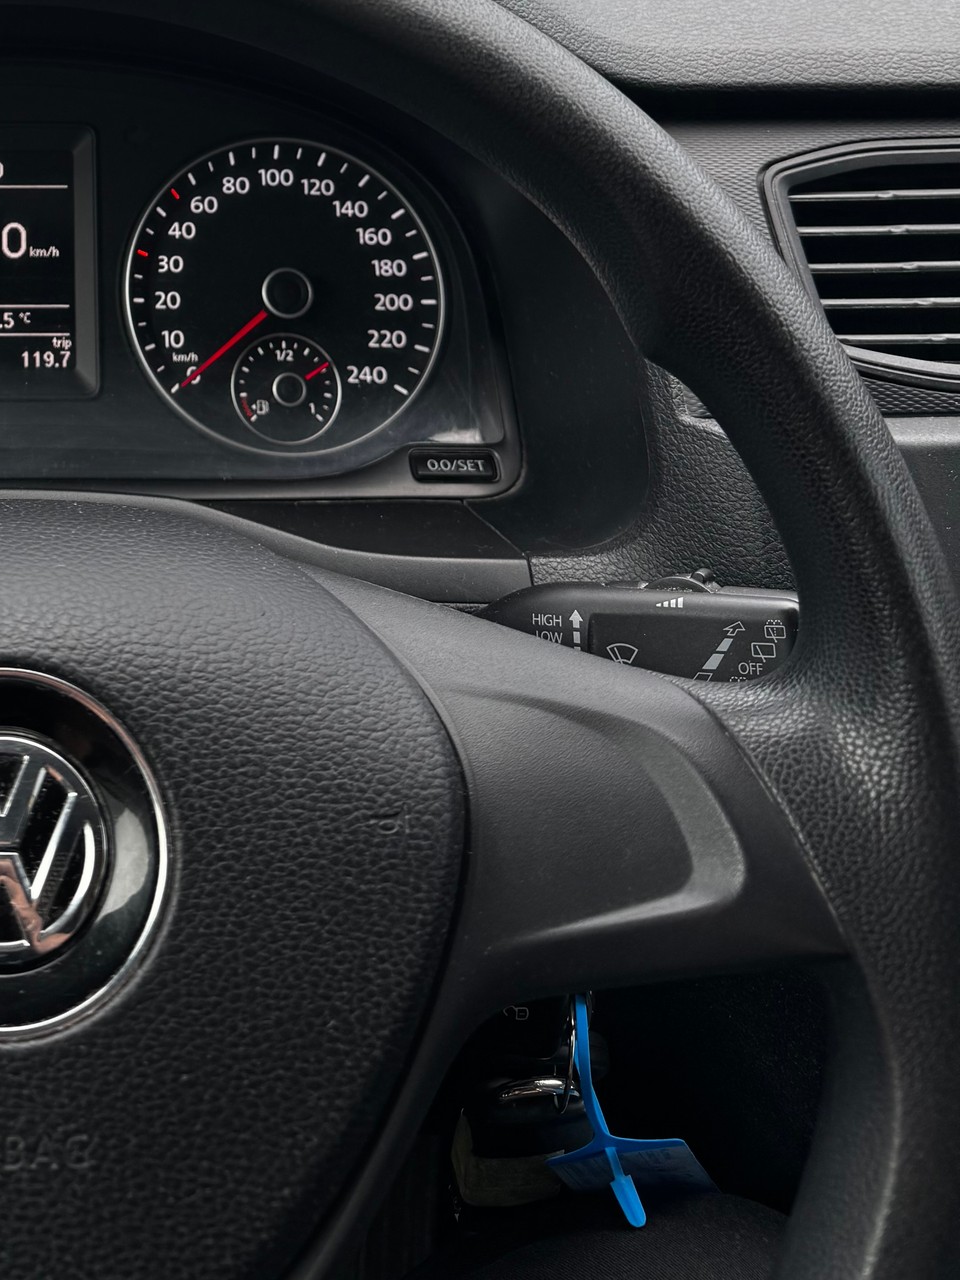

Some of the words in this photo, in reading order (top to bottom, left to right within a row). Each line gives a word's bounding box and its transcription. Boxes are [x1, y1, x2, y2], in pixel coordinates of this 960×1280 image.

[223, 177, 249, 194] 80
[258, 169, 293, 186] 100
[301, 179, 334, 196] 120
[191, 196, 218, 213] 60
[333, 201, 368, 217] 140
[168, 222, 196, 239] 40
[356, 228, 392, 245] 160
[2, 222, 26, 258] 0
[30, 246, 59, 257] km/h
[158, 255, 183, 273] 30
[372, 259, 407, 276] 180
[155, 291, 180, 309] 20
[375, 294, 413, 311] 200
[52, 337, 72, 350] trip
[162, 330, 184, 348] 10
[368, 330, 406, 348] 220
[22, 351, 70, 367] 119.7
[173, 352, 198, 362] km/h
[275, 349, 295, 361] 1/2
[347, 366, 387, 384] 240
[533, 613, 562, 627] HIGH
[738, 662, 762, 675] OFF
